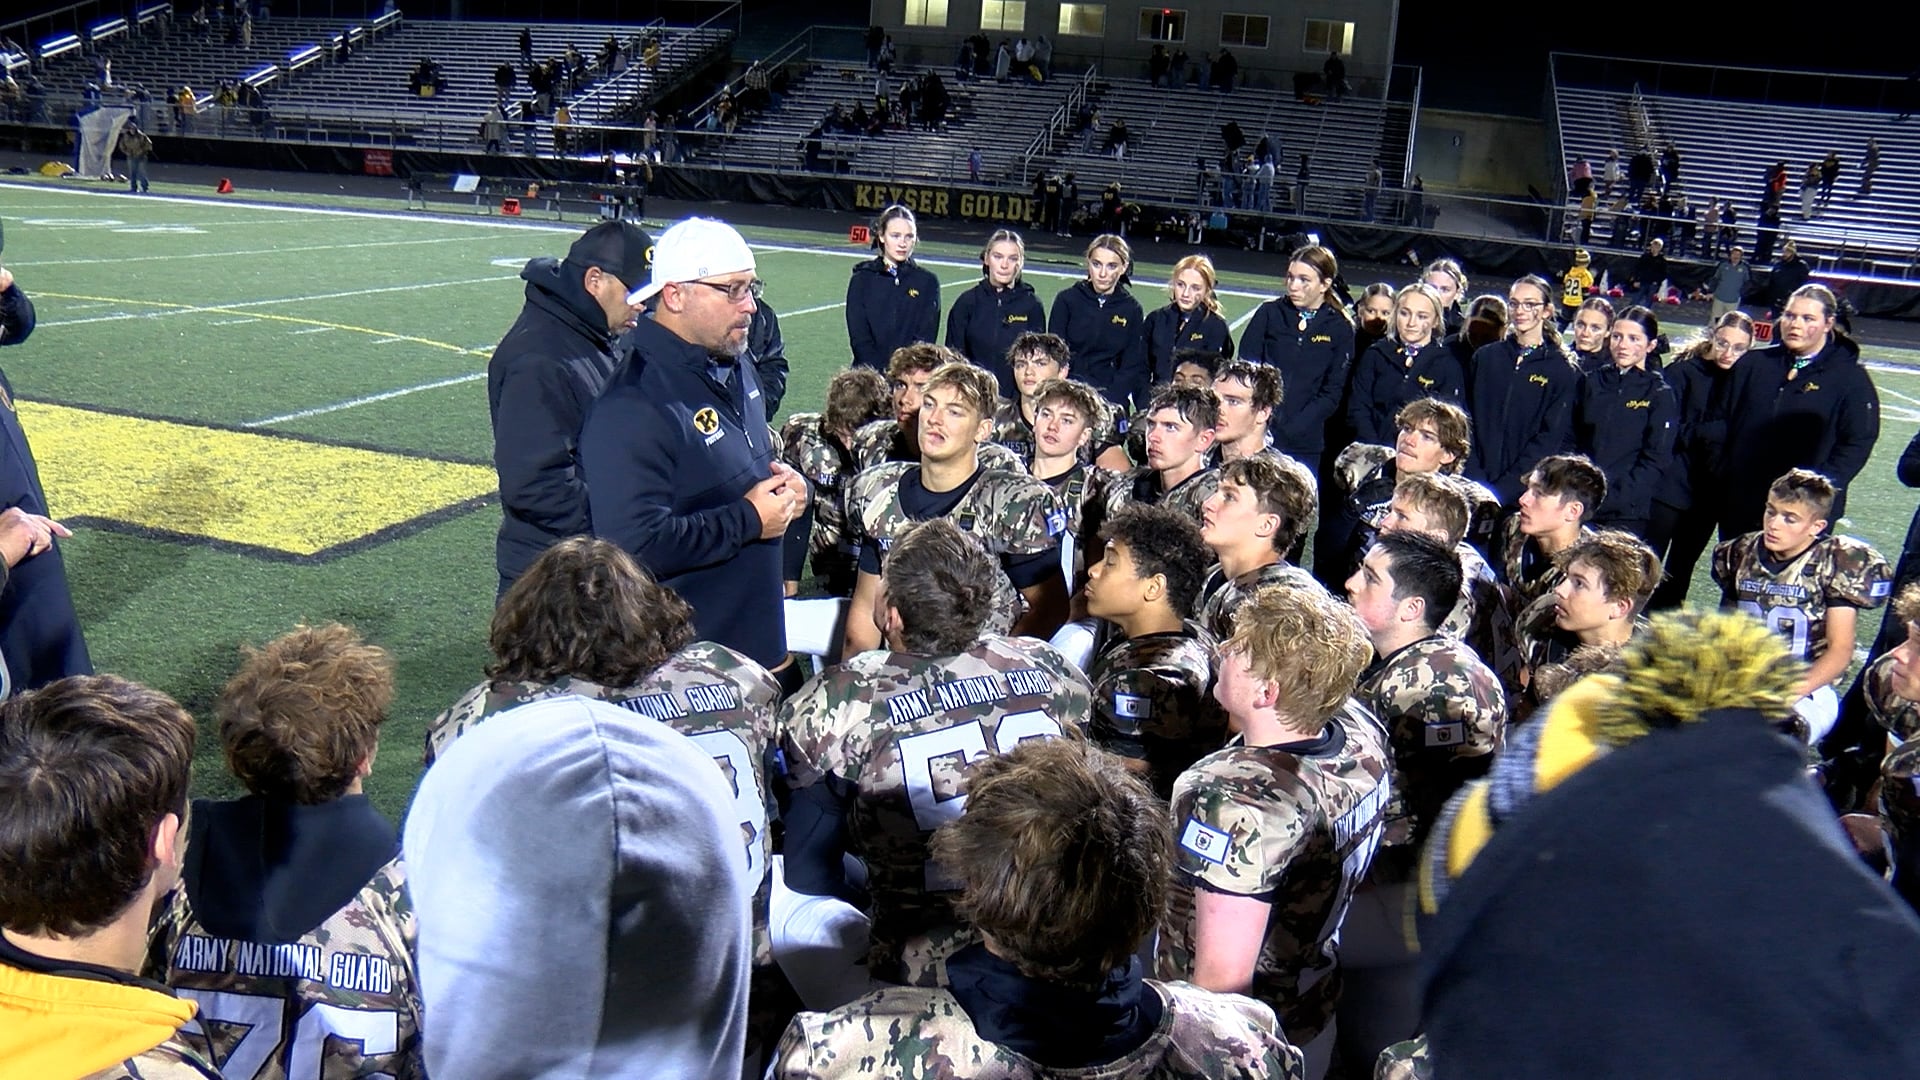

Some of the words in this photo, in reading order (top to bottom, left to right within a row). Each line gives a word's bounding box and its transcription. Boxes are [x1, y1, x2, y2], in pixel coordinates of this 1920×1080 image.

[855, 184, 949, 215] KEYSER
[960, 192, 1046, 223] GOLDE
[852, 228, 867, 242] 50
[1564, 279, 1580, 297] 22
[695, 408, 718, 433] K
[686, 684, 736, 713] GUARD
[888, 691, 933, 725] ARMY
[938, 675, 1006, 709] NATIONAL
[1007, 670, 1051, 696] GUARD
[179, 936, 231, 972] ARMY
[239, 941, 324, 982] NATIONAL
[331, 953, 392, 994] GUARD
